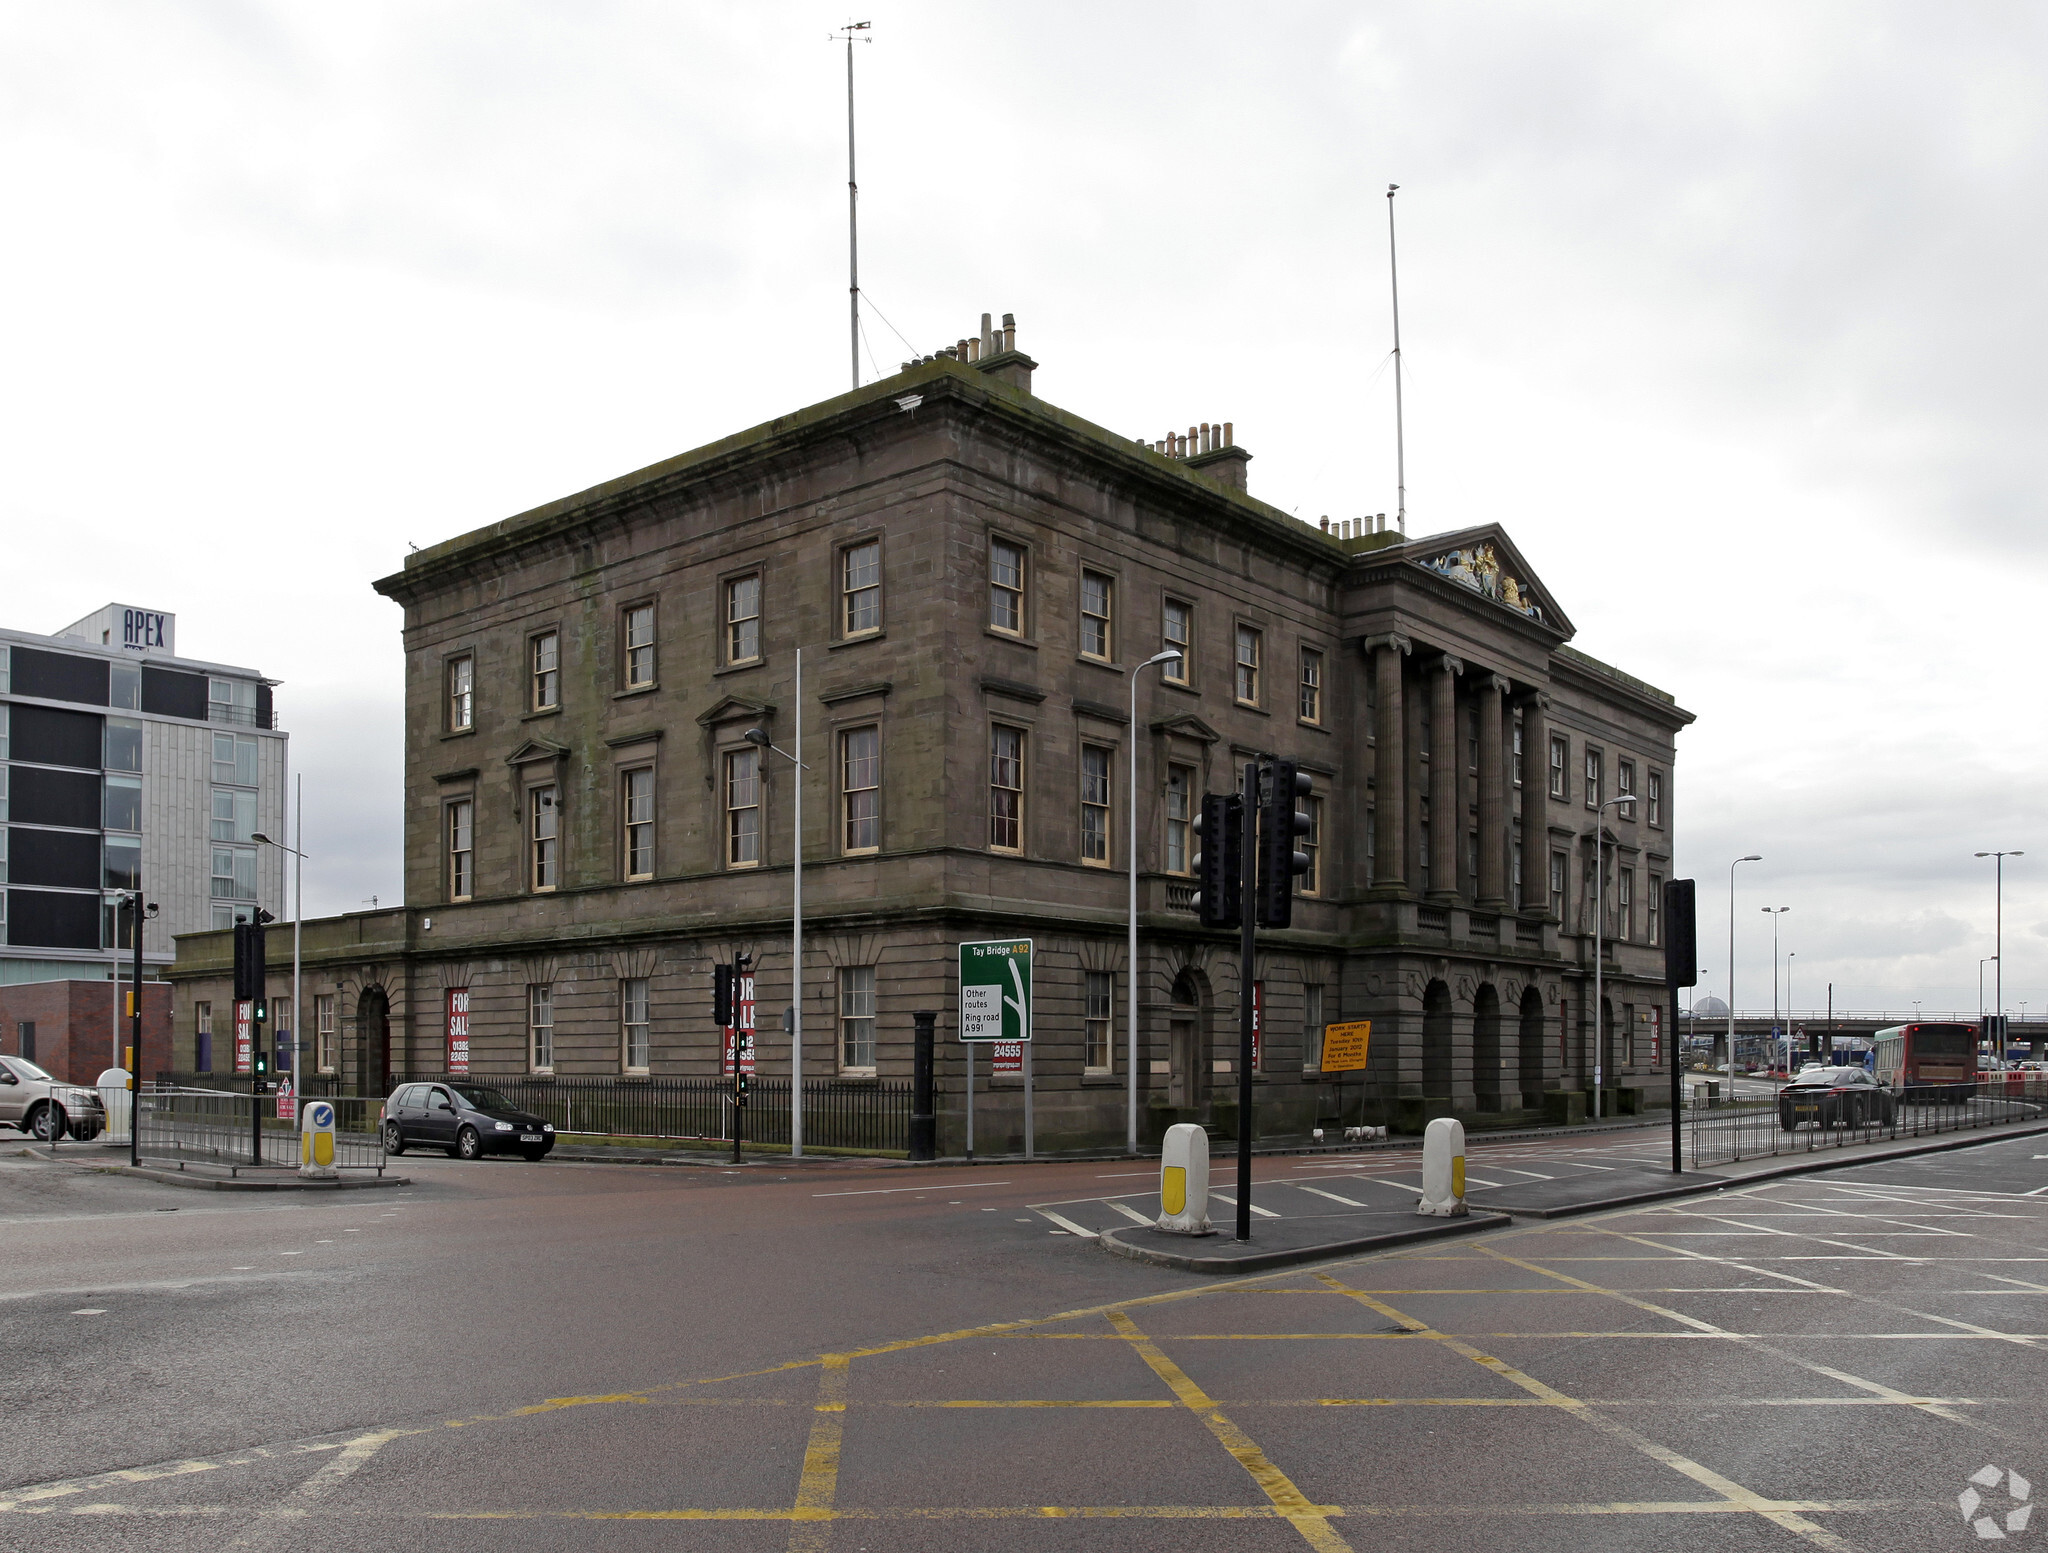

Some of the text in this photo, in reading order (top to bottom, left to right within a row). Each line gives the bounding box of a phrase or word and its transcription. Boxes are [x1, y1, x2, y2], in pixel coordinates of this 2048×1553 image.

[124, 609, 165, 647] APEX
[972, 944, 1029, 957] Tay Bridge A92
[966, 990, 986, 998] Other
[965, 1000, 988, 1008] routes
[965, 1012, 1000, 1023] Ring road
[238, 1023, 250, 1040] SAL
[965, 1024, 984, 1032] A991
[450, 1051, 469, 1062] 22455
[994, 1045, 1021, 1058] 24555
